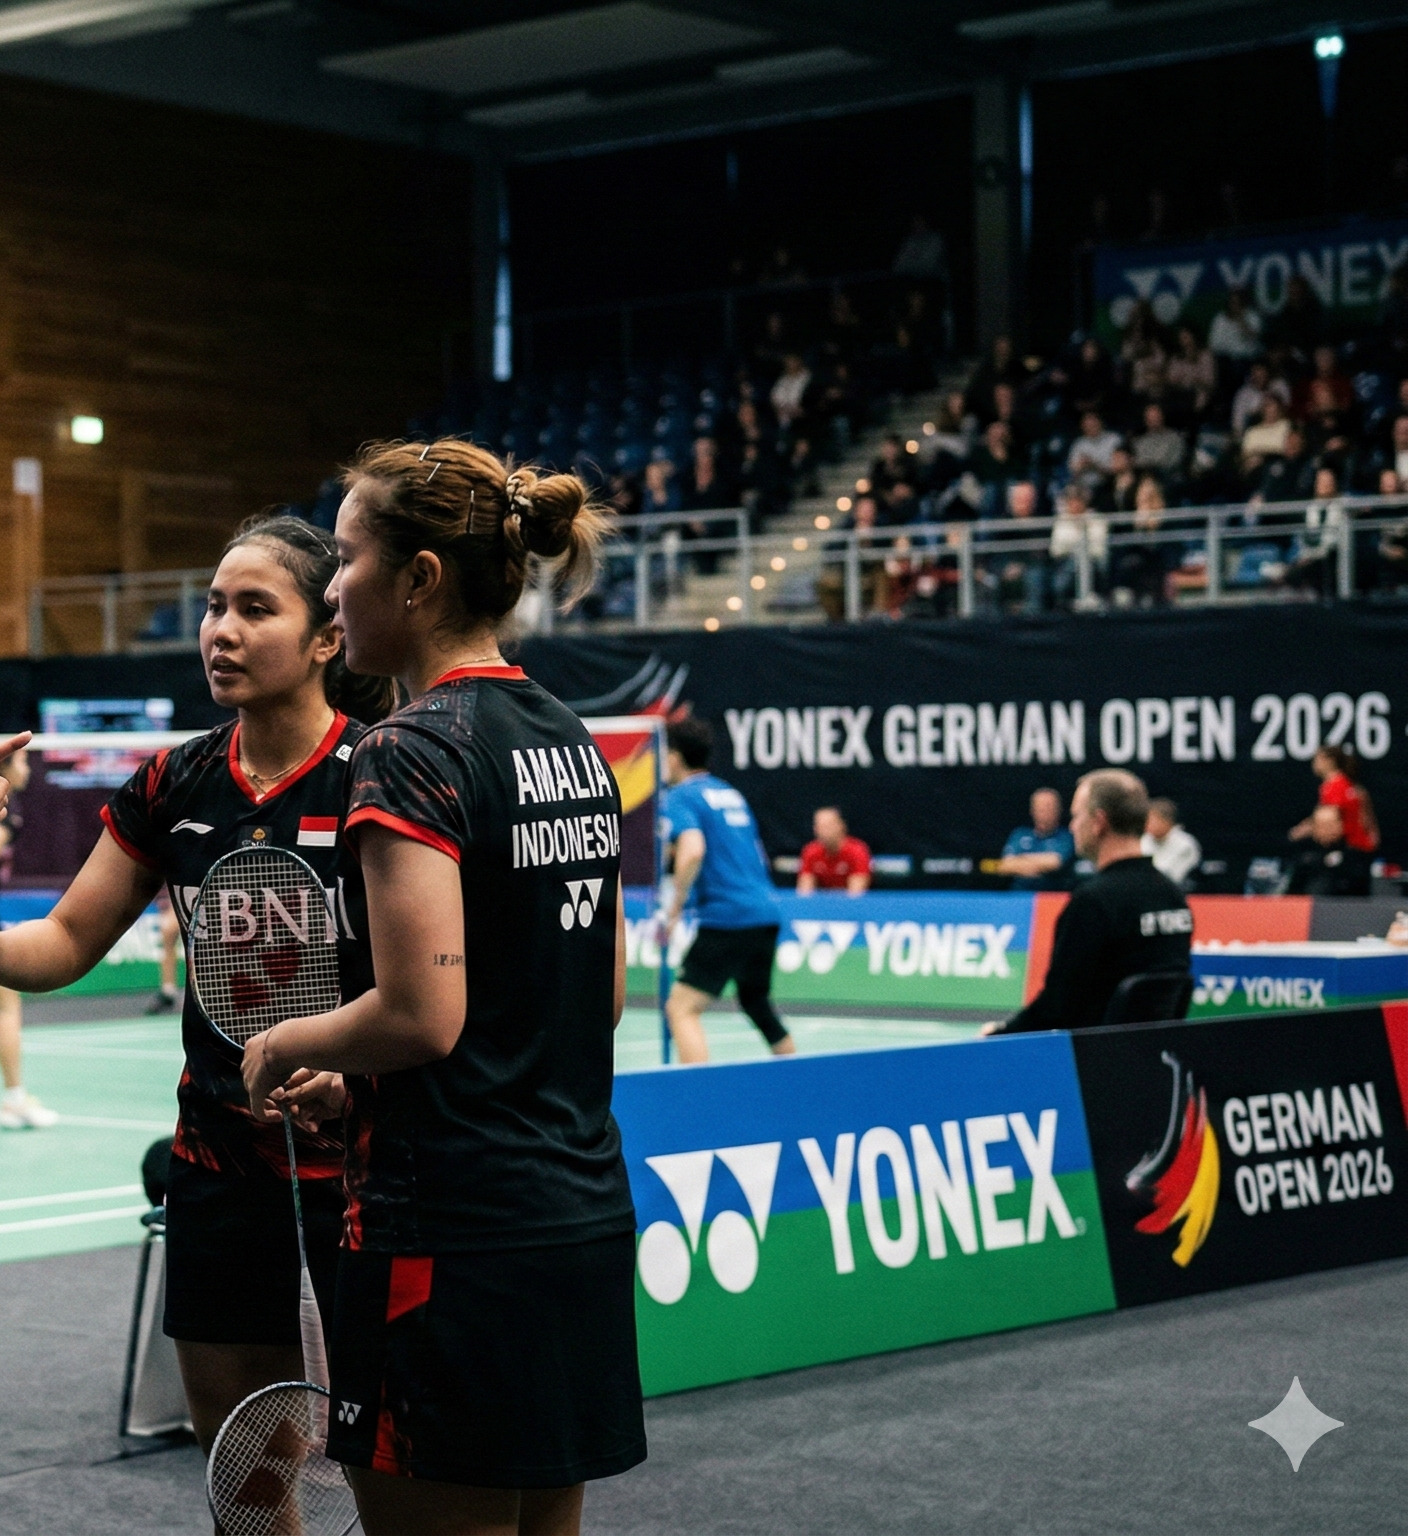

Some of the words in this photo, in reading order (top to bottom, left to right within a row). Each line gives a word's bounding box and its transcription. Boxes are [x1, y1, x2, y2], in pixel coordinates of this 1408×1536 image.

[724, 706, 872, 769] YONEX
[883, 700, 1086, 768] GERMAN
[1100, 695, 1236, 764] OPEN
[1250, 691, 1391, 762] 2026
[512, 745, 613, 805] AMALIA
[512, 813, 620, 869] INDONESIA
[864, 923, 1017, 978] YONEX
[1241, 977, 1326, 1008] YONEX
[1223, 1082, 1383, 1157] GERMAN
[797, 1109, 1077, 1275] YONEX
[1234, 1158, 1319, 1216] OPEN
[1322, 1147, 1392, 1201] 2026
